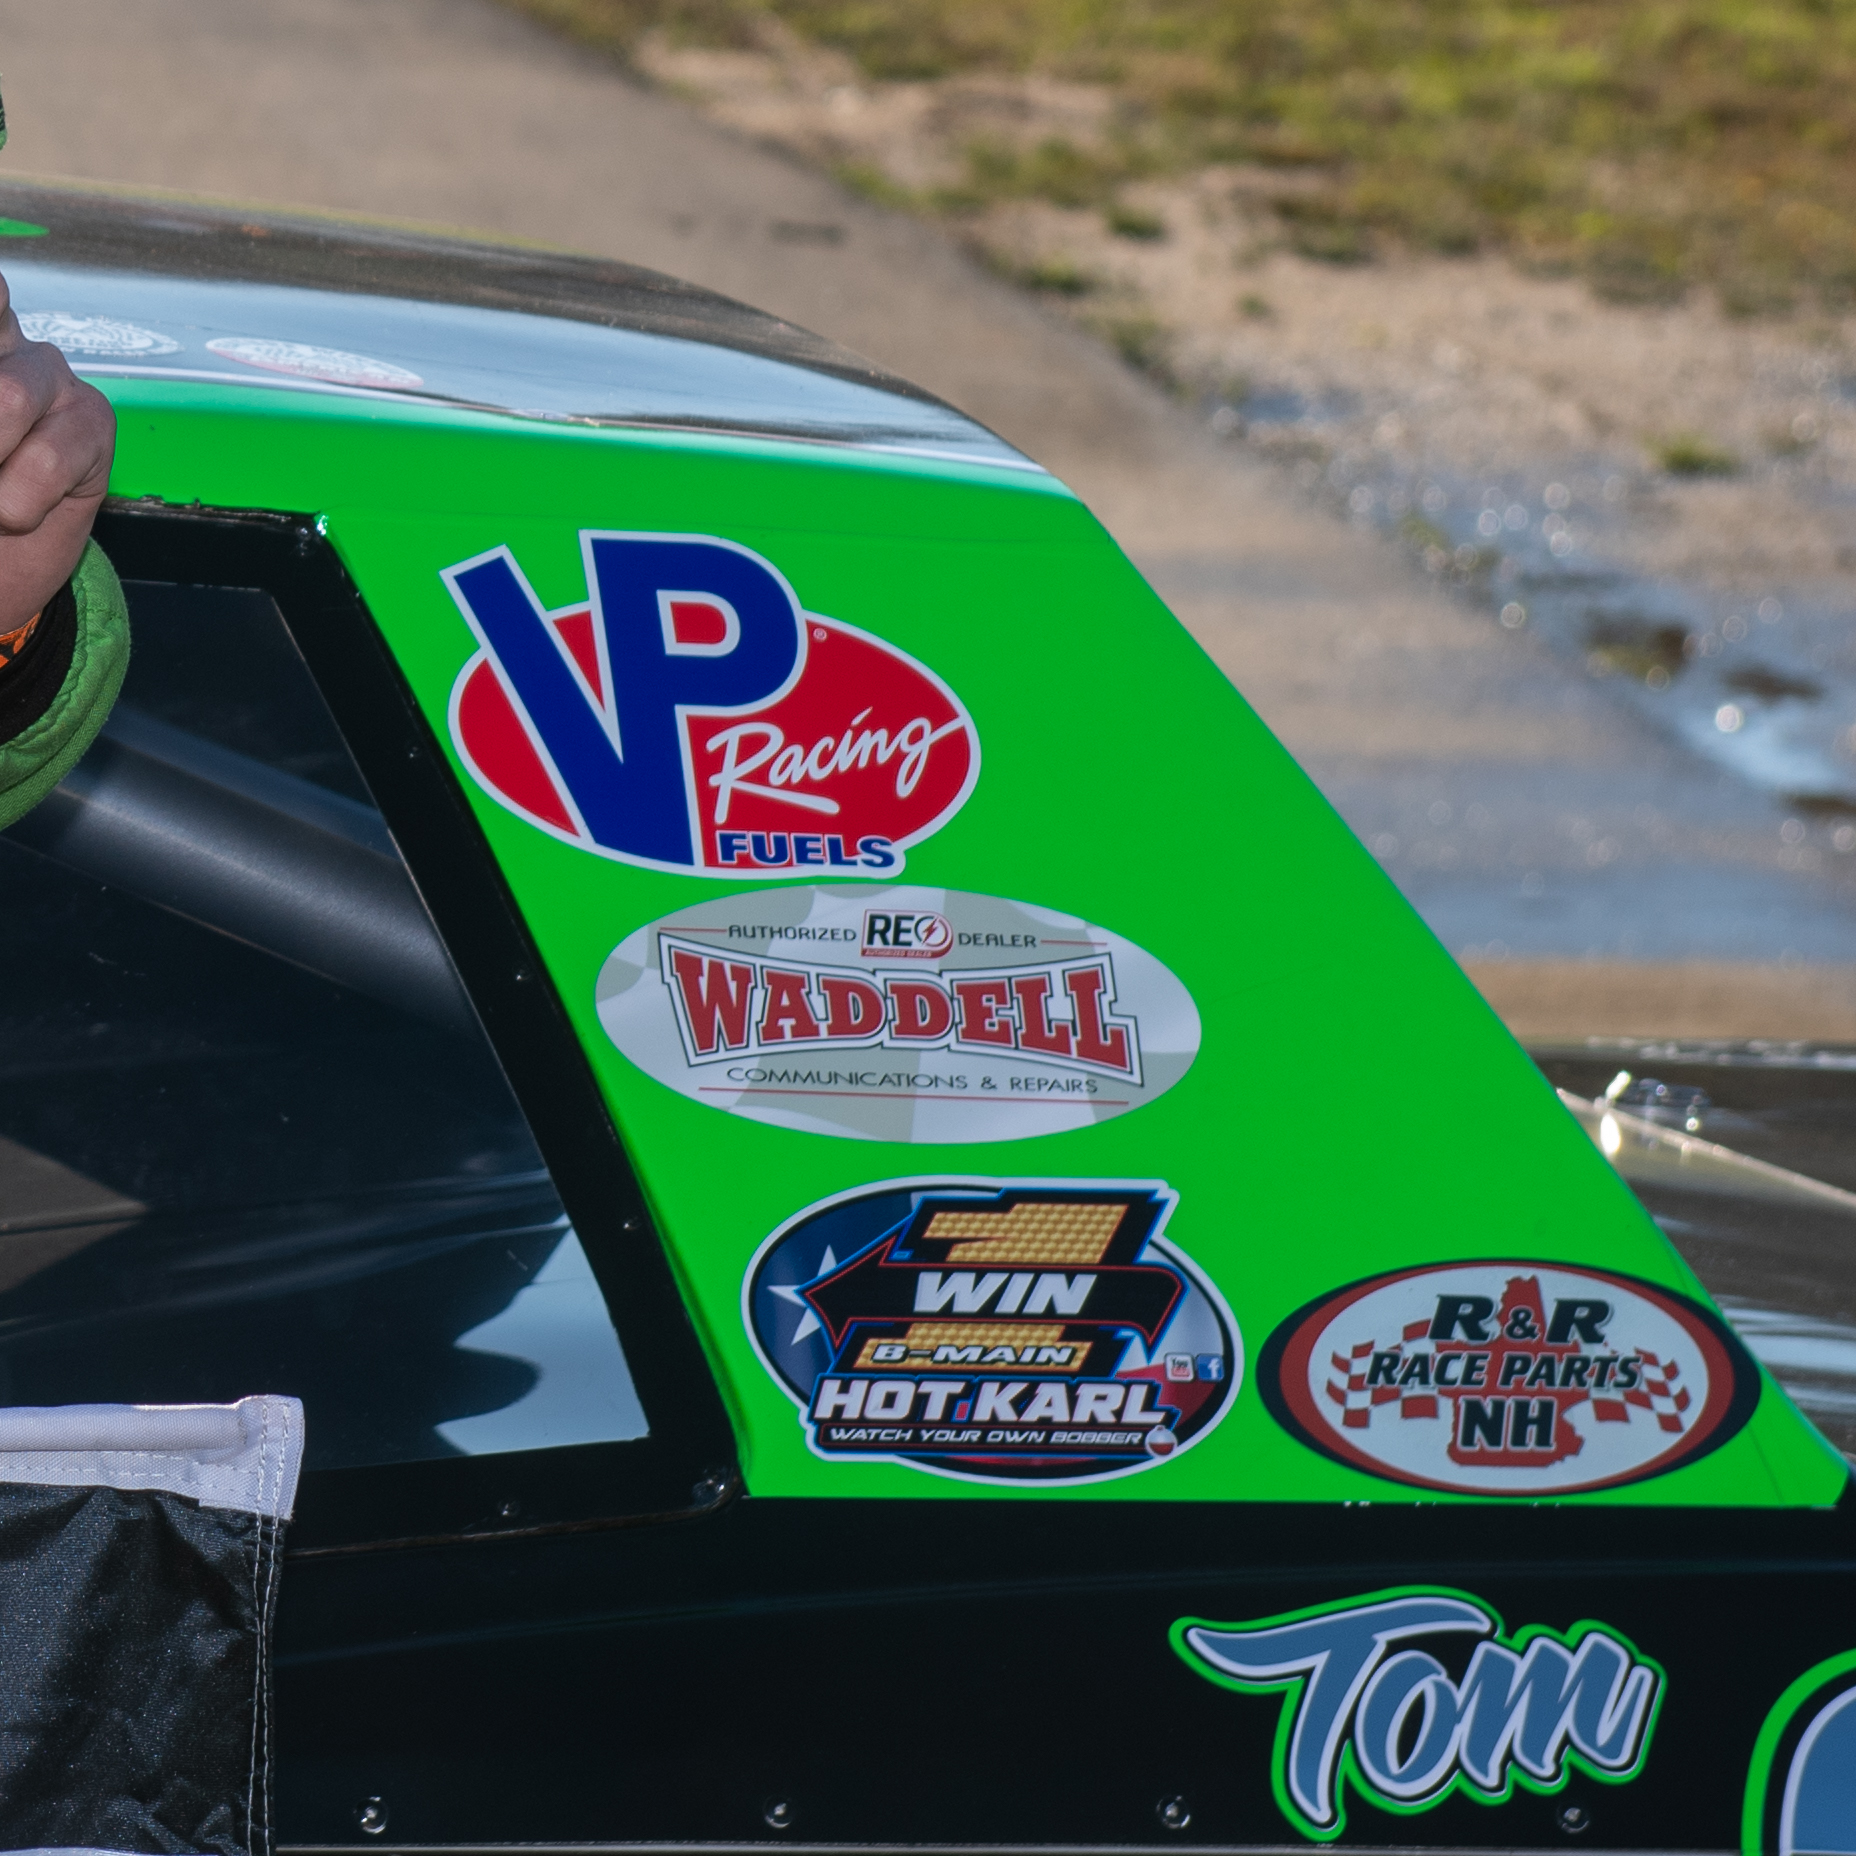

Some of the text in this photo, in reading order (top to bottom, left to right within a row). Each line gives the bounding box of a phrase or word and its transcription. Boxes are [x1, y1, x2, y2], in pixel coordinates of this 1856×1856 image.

[440, 530, 807, 868] VP
[706, 706, 950, 825] Racing
[716, 830, 897, 871] FUELS
[728, 924, 857, 943] AUTHORIZED
[957, 931, 1038, 949] DEALER
[666, 944, 1138, 1080] WADDELL
[726, 1065, 1100, 1095] COMMUNICATIONS & REPAIRS
[912, 1271, 1098, 1316] WIN
[872, 1343, 1075, 1365] B-MAIN
[1365, 1350, 1644, 1390] RACE PARTS
[972, 1381, 1167, 1424] KARL
[1457, 1396, 1557, 1450] NH
[829, 1427, 1143, 1446] WATCH YOUR OWN BOBBER
[1183, 1594, 1658, 1828] Tom
